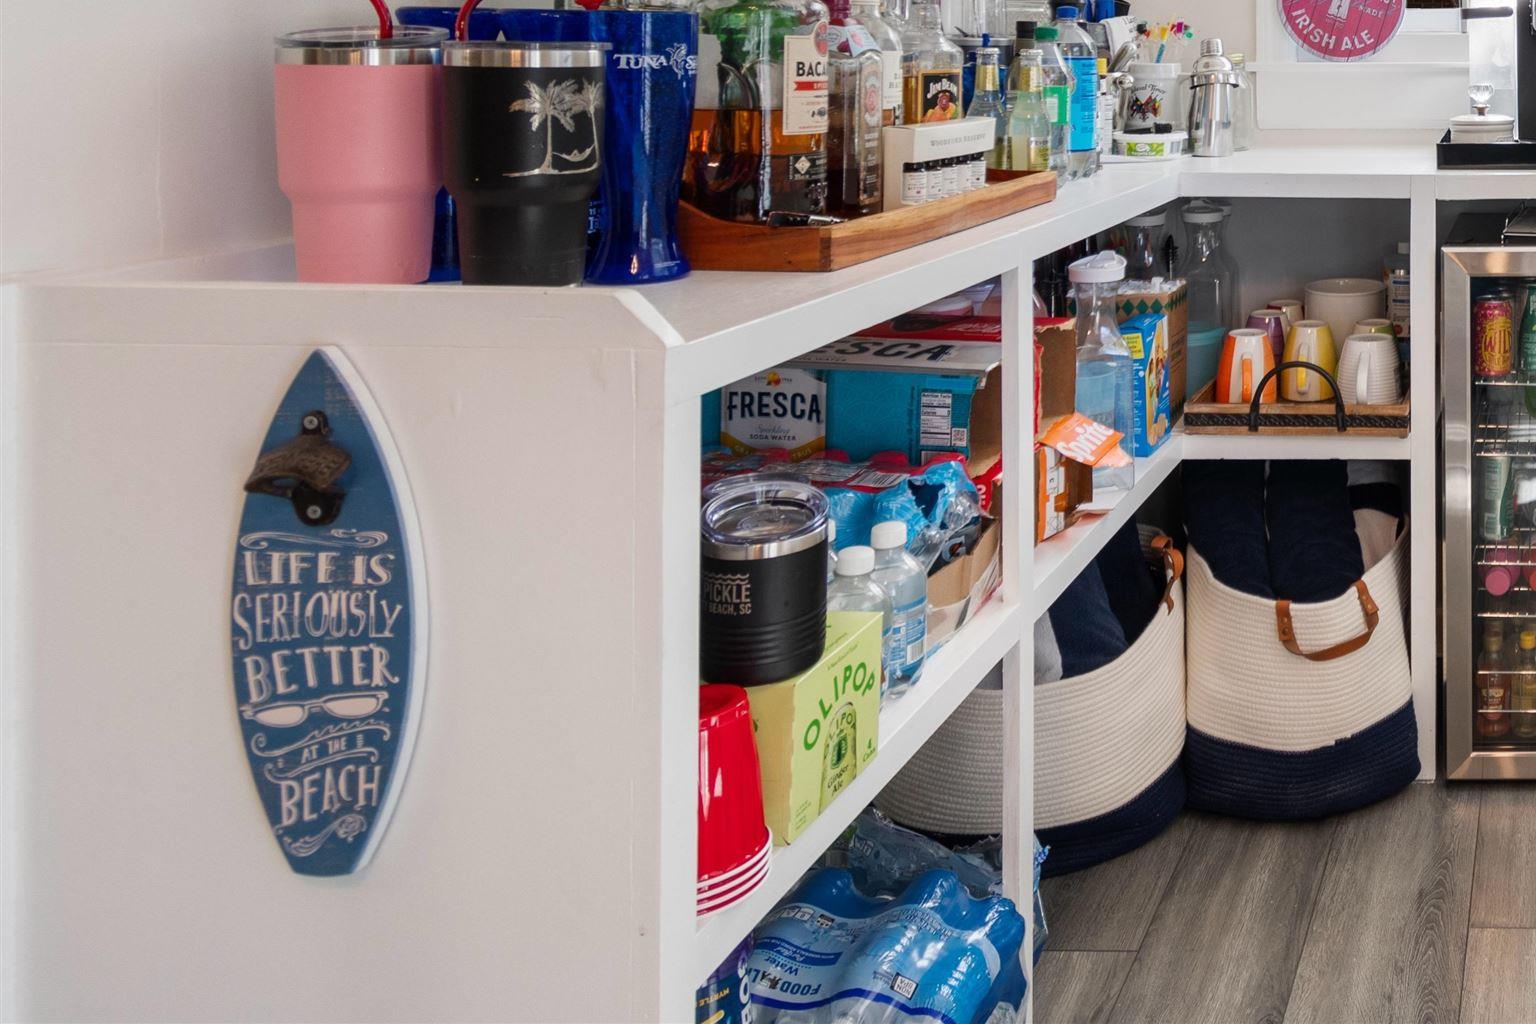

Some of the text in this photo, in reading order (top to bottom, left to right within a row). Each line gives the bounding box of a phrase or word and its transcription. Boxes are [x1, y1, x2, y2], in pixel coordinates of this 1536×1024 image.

[1290, 8, 1375, 51] IRISH ALE
[612, 53, 668, 70] TUNA
[727, 391, 822, 424] FRESCA
[243, 551, 395, 587] LIFE IS
[703, 582, 751, 603] PICKLE
[233, 588, 402, 651] SERIOUSLY
[244, 645, 400, 704] BETTER
[803, 661, 875, 752] OLIPOP
[300, 737, 347, 762] AT THE
[279, 764, 382, 827] BEACH
[831, 778, 844, 796] Ale
[764, 956, 799, 977] Water
[779, 979, 822, 996] FOOD
